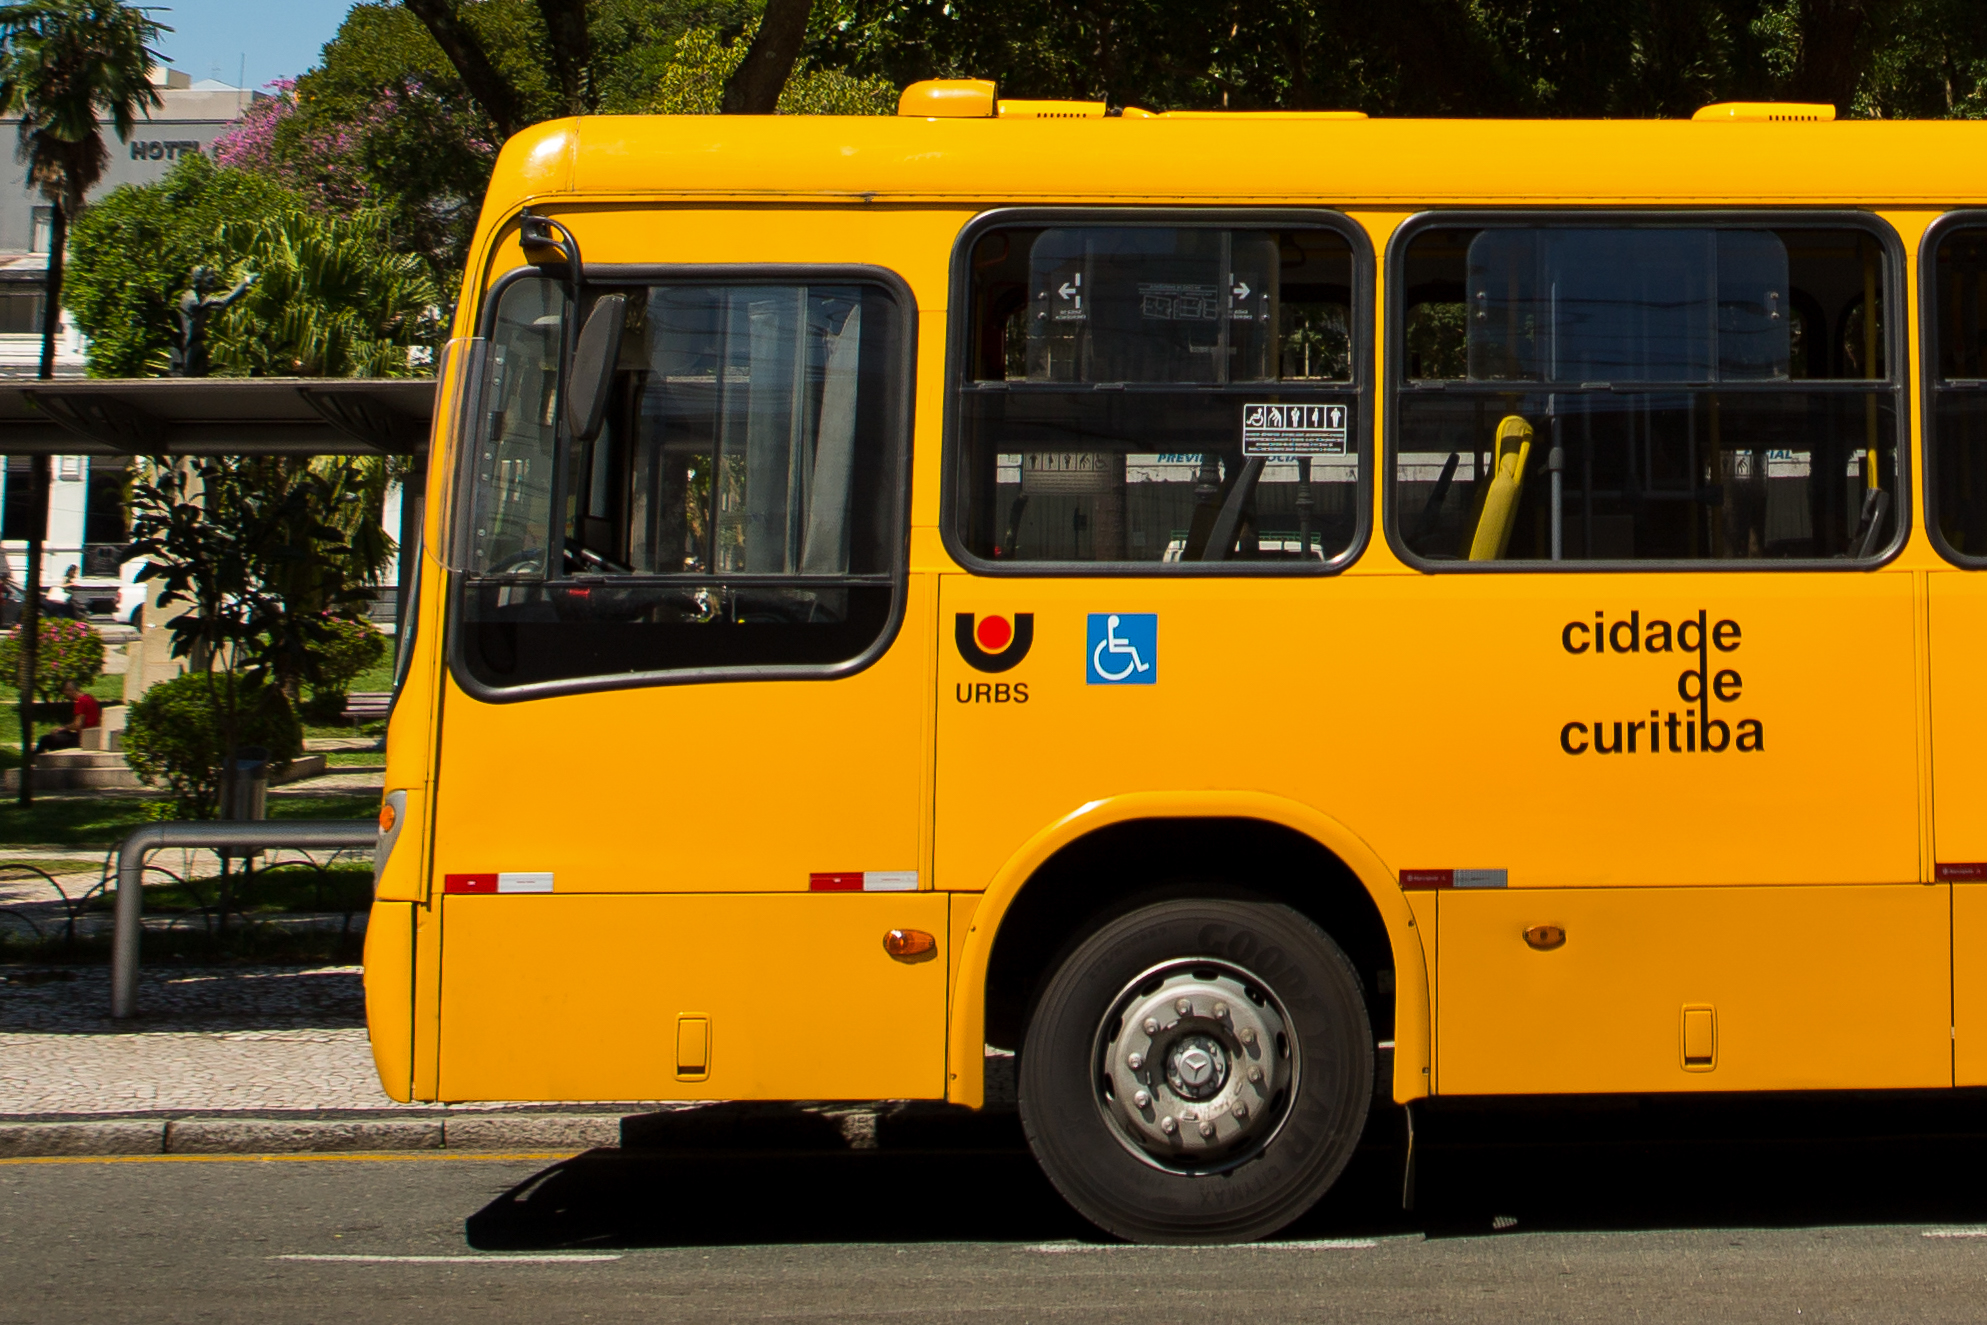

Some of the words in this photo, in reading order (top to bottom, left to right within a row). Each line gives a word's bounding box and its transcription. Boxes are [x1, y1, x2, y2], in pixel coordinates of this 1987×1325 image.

[1157, 453, 1204, 463] PREVI
[1561, 609, 1742, 655] cidade
[956, 682, 1030, 704] URBS
[1677, 661, 1742, 703] de
[1559, 708, 1765, 756] curitiba
[1197, 923, 1336, 1165] GOODYEAR
